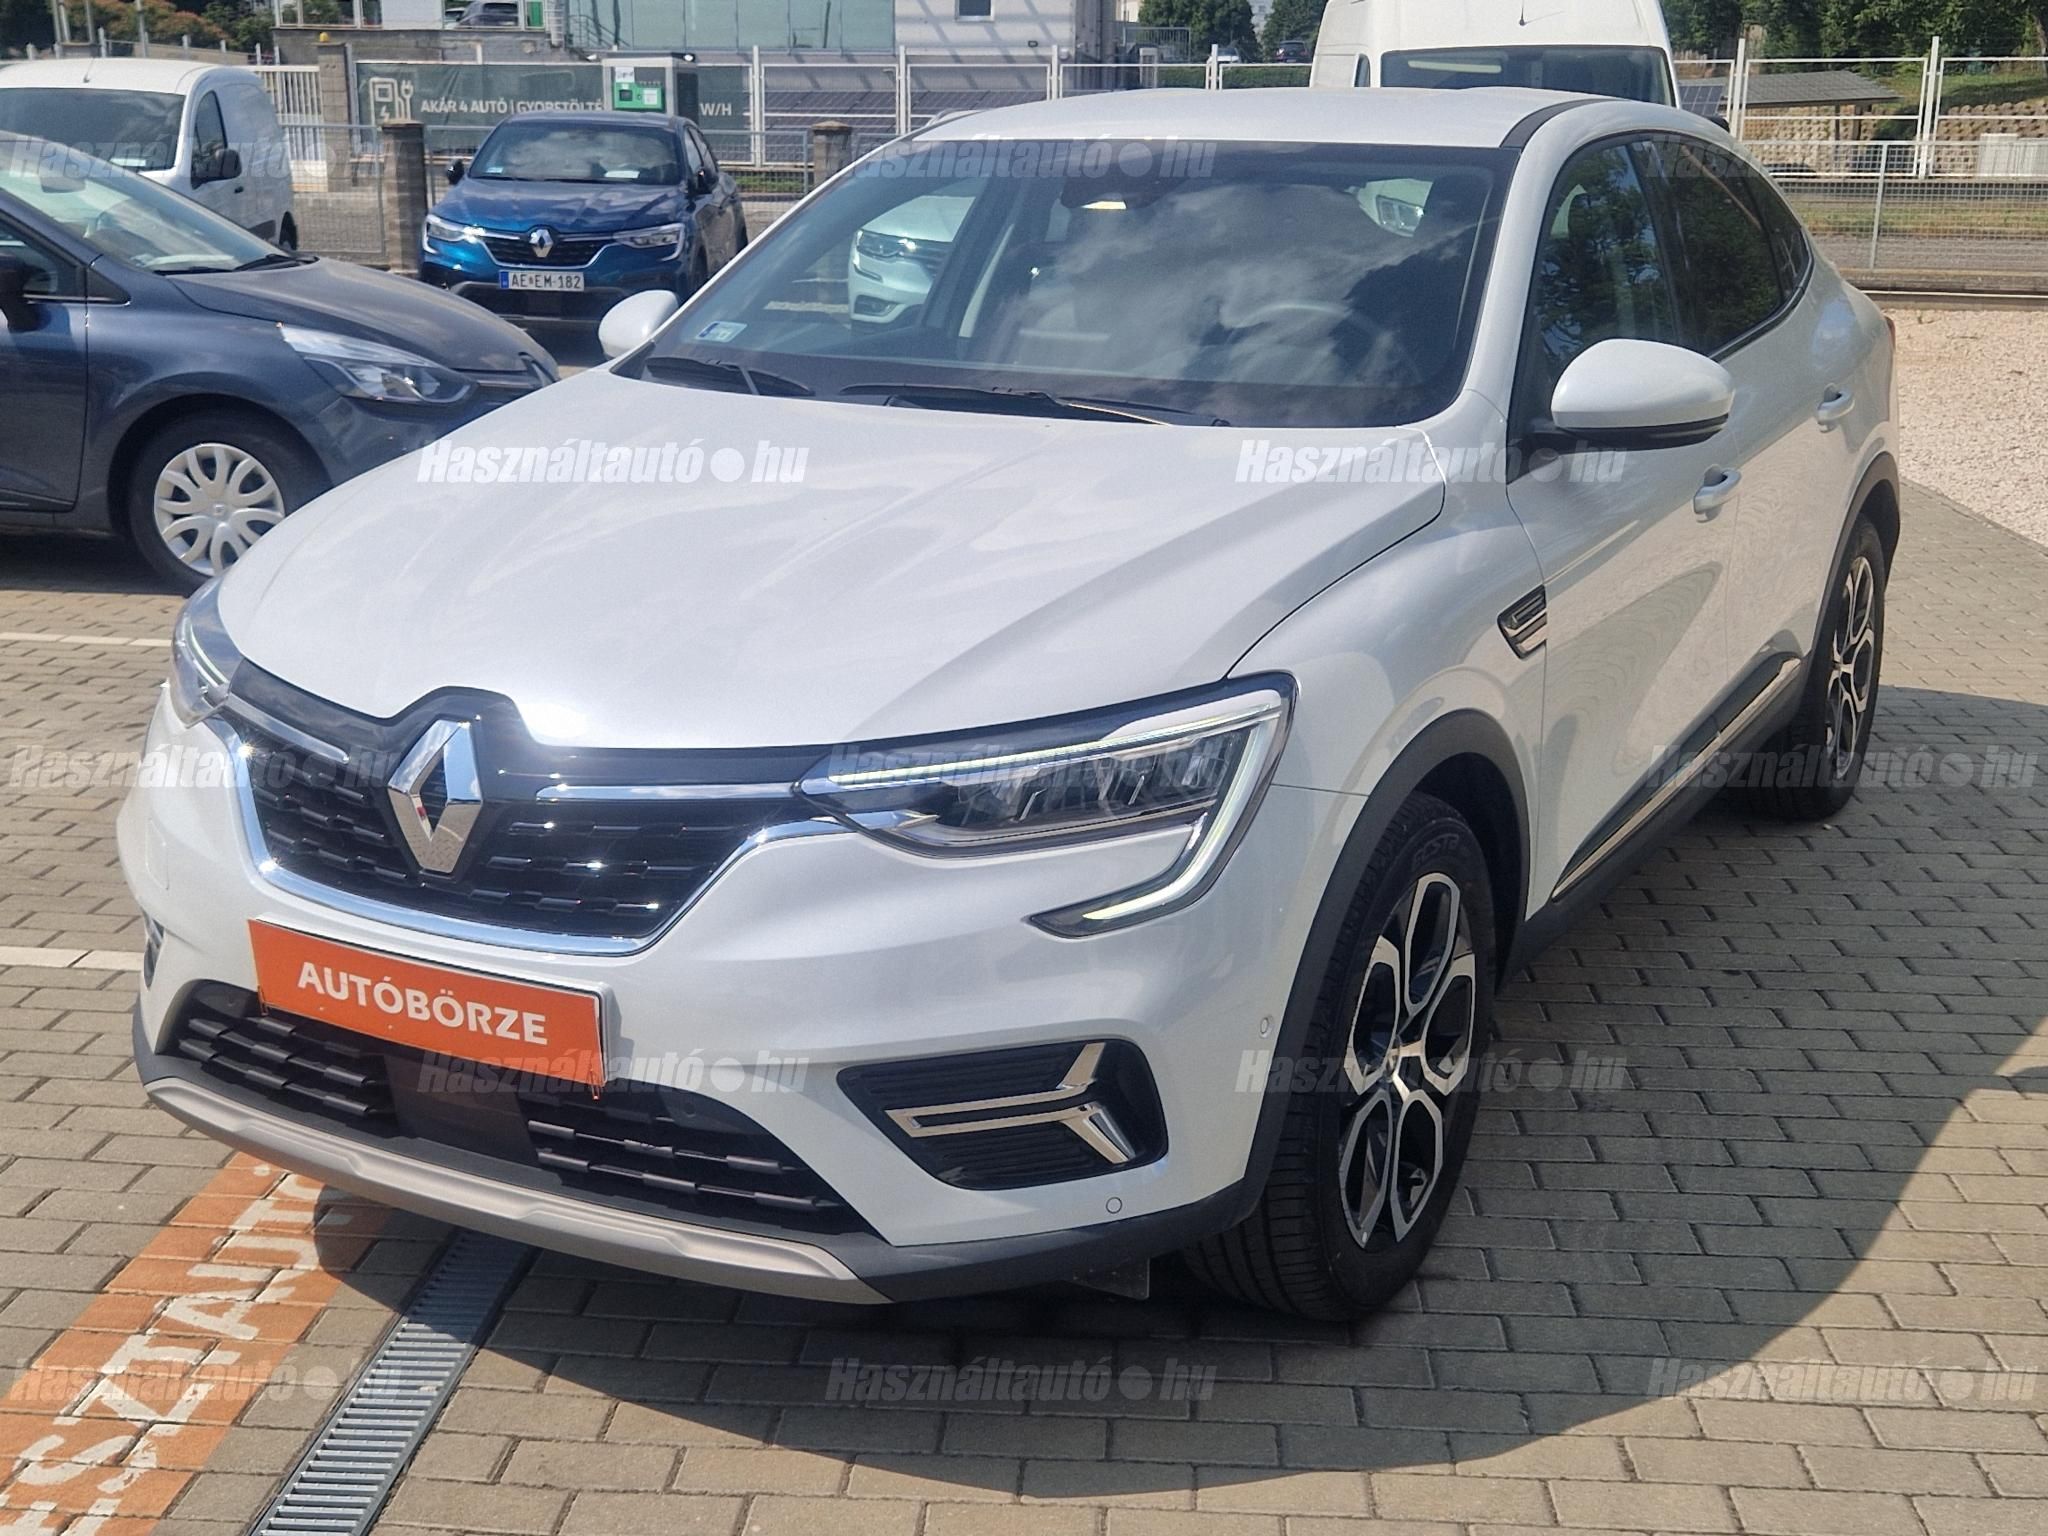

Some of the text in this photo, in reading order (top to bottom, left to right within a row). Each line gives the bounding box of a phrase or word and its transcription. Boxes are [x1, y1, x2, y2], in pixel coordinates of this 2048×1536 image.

[420, 96, 456, 113] AKÁR
[458, 101, 468, 113] 4
[470, 97, 507, 114] AUTÓ
[511, 273, 581, 289] AE EM-182
[297, 961, 549, 1045] AUTÓBÖRZE
